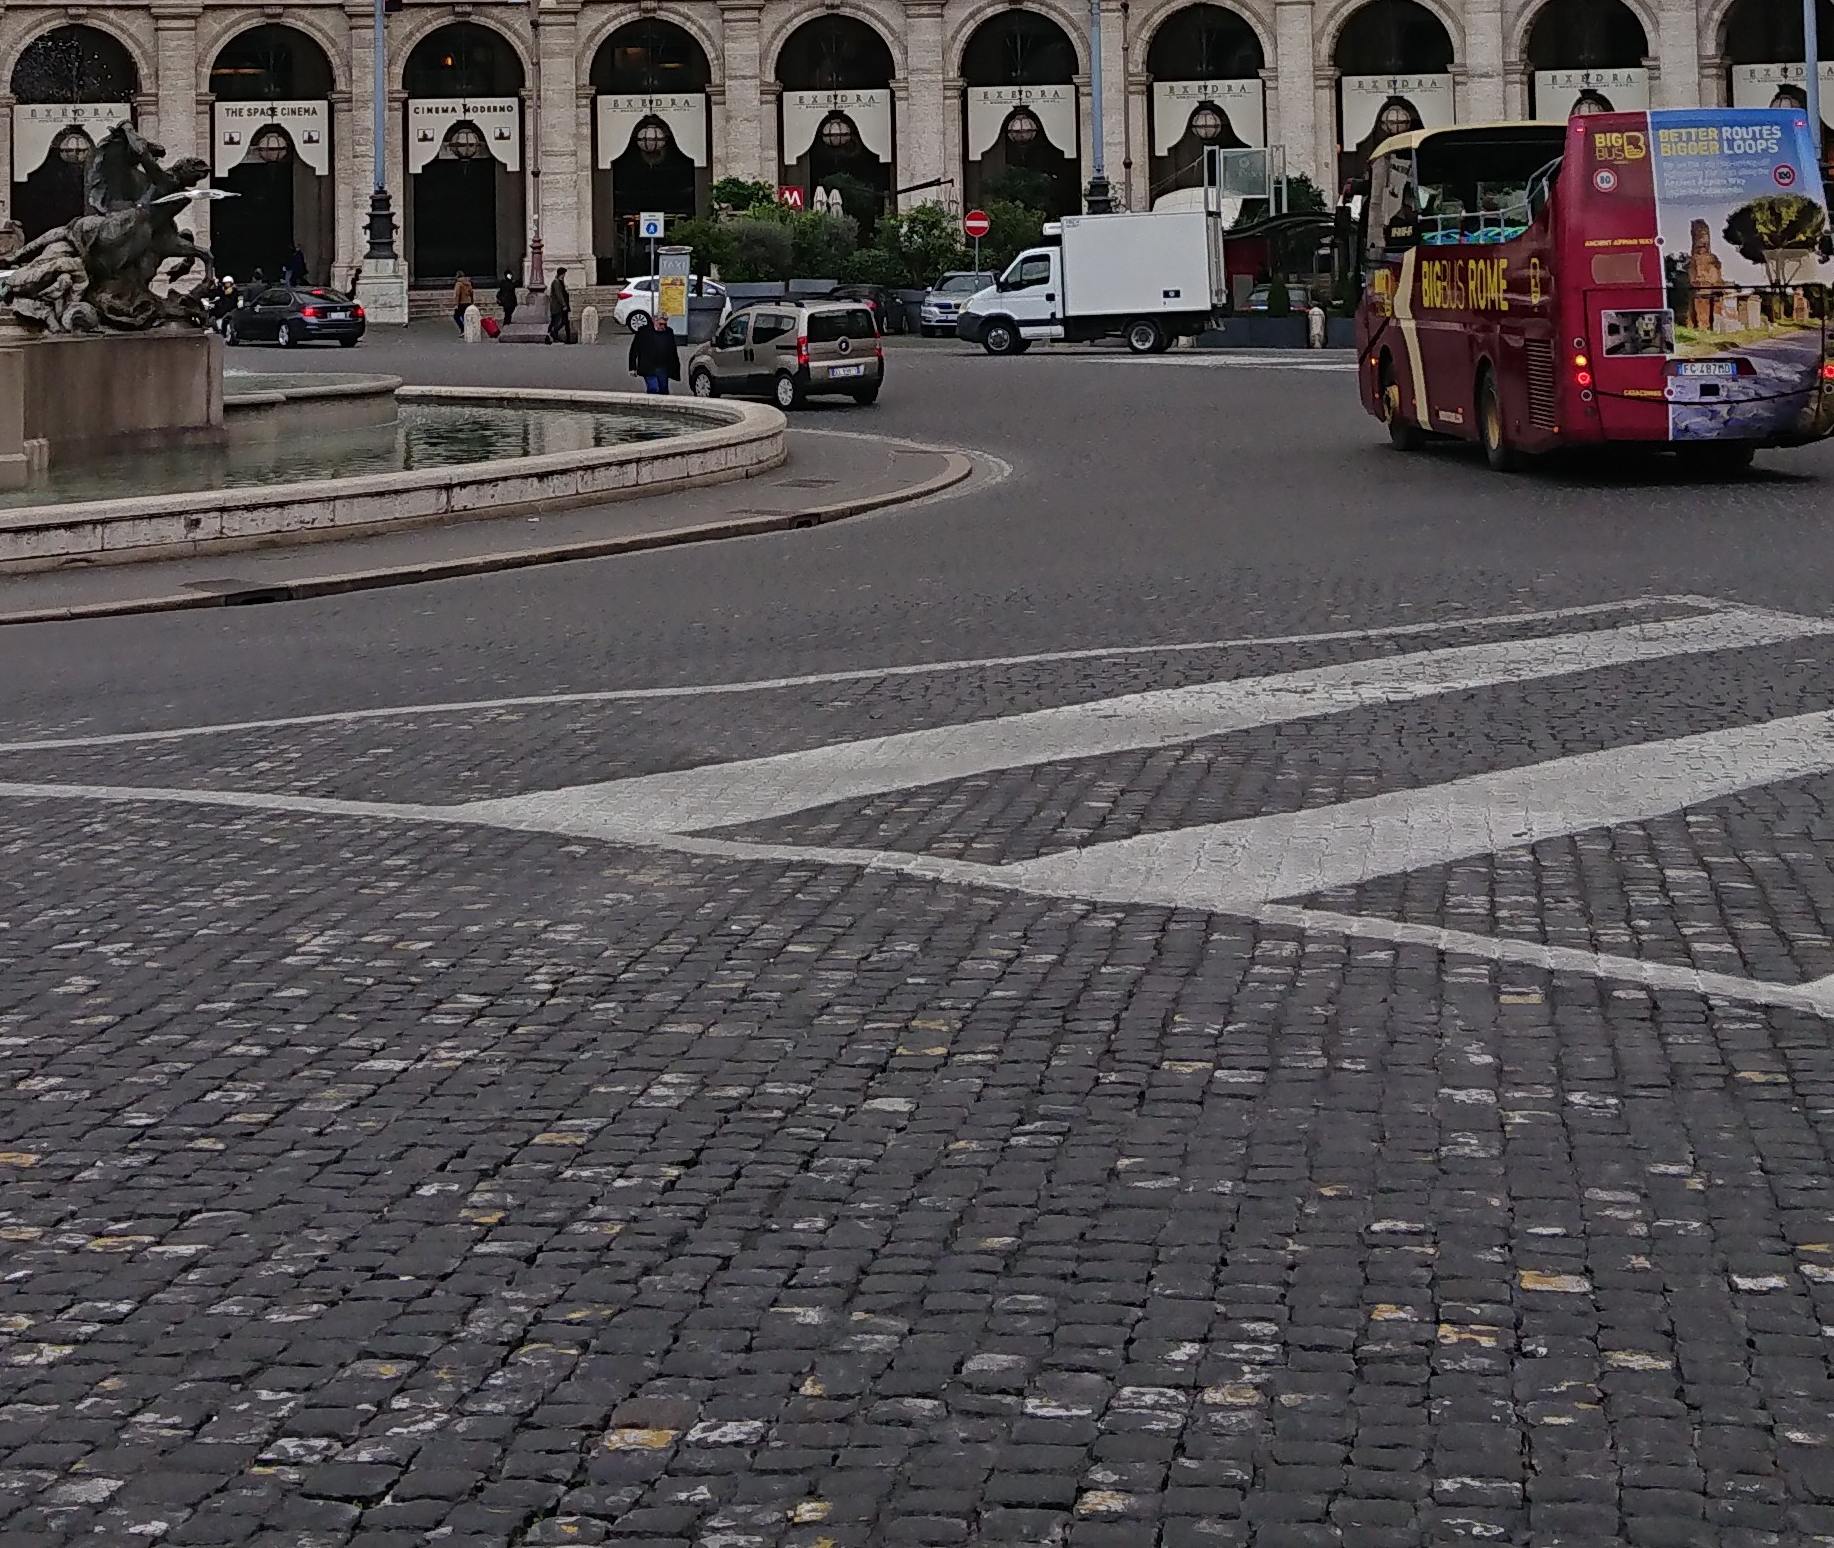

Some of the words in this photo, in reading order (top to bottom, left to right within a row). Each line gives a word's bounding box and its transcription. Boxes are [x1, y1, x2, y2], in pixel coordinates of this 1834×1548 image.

[1749, 66, 1834, 79] EXEDA
[982, 89, 1060, 99] EXEDRA
[1168, 84, 1247, 94] EXEDRA
[612, 98, 690, 108] EXEDRA
[798, 94, 876, 104] EXEDRA
[30, 107, 115, 118] EXEDRA
[225, 108, 244, 117] THE
[246, 107, 278, 117] SPACE
[281, 106, 318, 117] CINEMA
[413, 106, 458, 114] CINEMA
[462, 104, 514, 113] MODERNO
[1659, 127, 1719, 142] BETTER
[1722, 125, 1782, 140] ROUTES
[1594, 132, 1623, 147] BIG
[1660, 140, 1720, 157] BIGGER
[1723, 138, 1779, 155] LOOPS
[1595, 147, 1624, 161] BUS
[782, 189, 802, 206] M
[662, 260, 686, 270] TAXI
[1468, 258, 1509, 311] ROME
